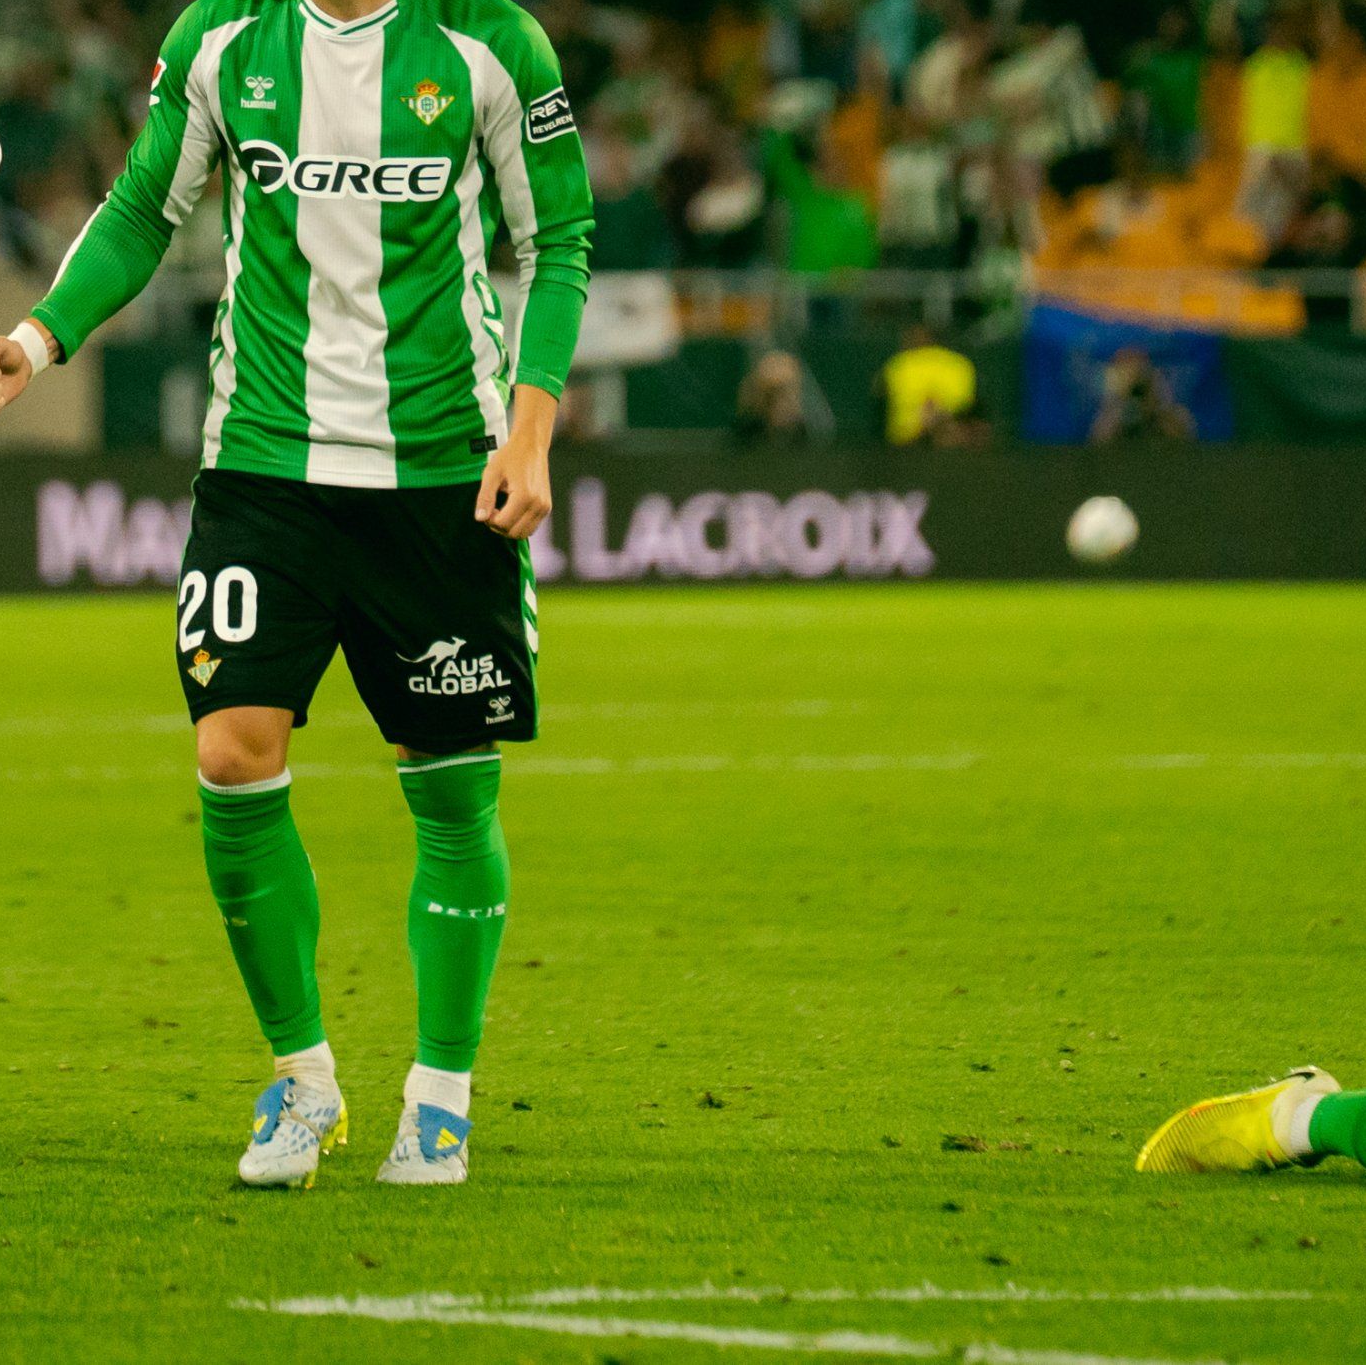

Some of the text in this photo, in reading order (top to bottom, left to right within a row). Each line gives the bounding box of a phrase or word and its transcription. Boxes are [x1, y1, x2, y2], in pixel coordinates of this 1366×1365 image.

[240, 98, 277, 110] hummel
[293, 160, 445, 196] GREE
[572, 478, 935, 580] LACROIX
[178, 565, 258, 653] 20
[441, 654, 495, 678] AUS
[408, 669, 512, 695] GLOBAL
